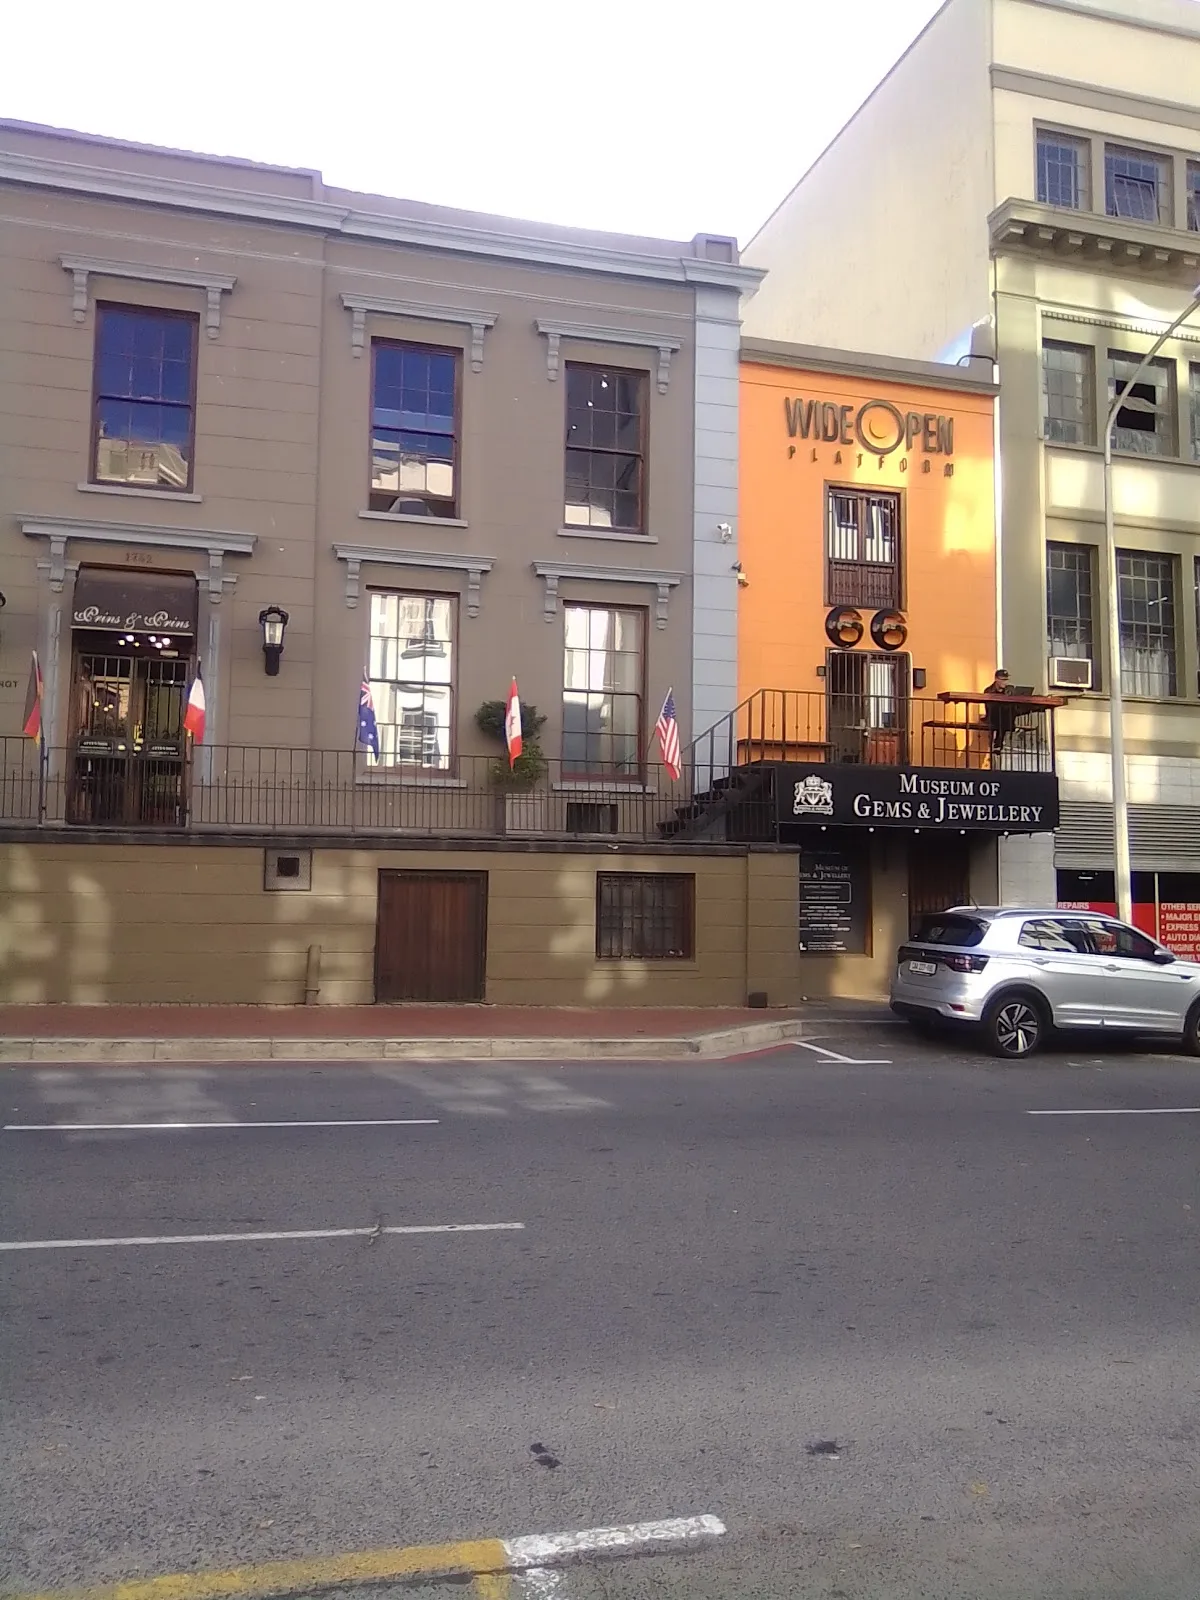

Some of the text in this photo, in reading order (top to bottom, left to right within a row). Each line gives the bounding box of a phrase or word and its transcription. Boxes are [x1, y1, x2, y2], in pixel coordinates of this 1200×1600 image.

[74, 606, 191, 630] Prins & Prins
[899, 774, 1001, 797] MUSEUM OF
[854, 794, 1043, 823] GEMS & JEWELLERY
[1057, 901, 1090, 910] REPAIRS
[1161, 903, 1186, 911] OTHER
[1165, 913, 1192, 921] MAJOR
[1165, 923, 1199, 931] EXPRESS
[1166, 933, 1187, 941] AUTO
